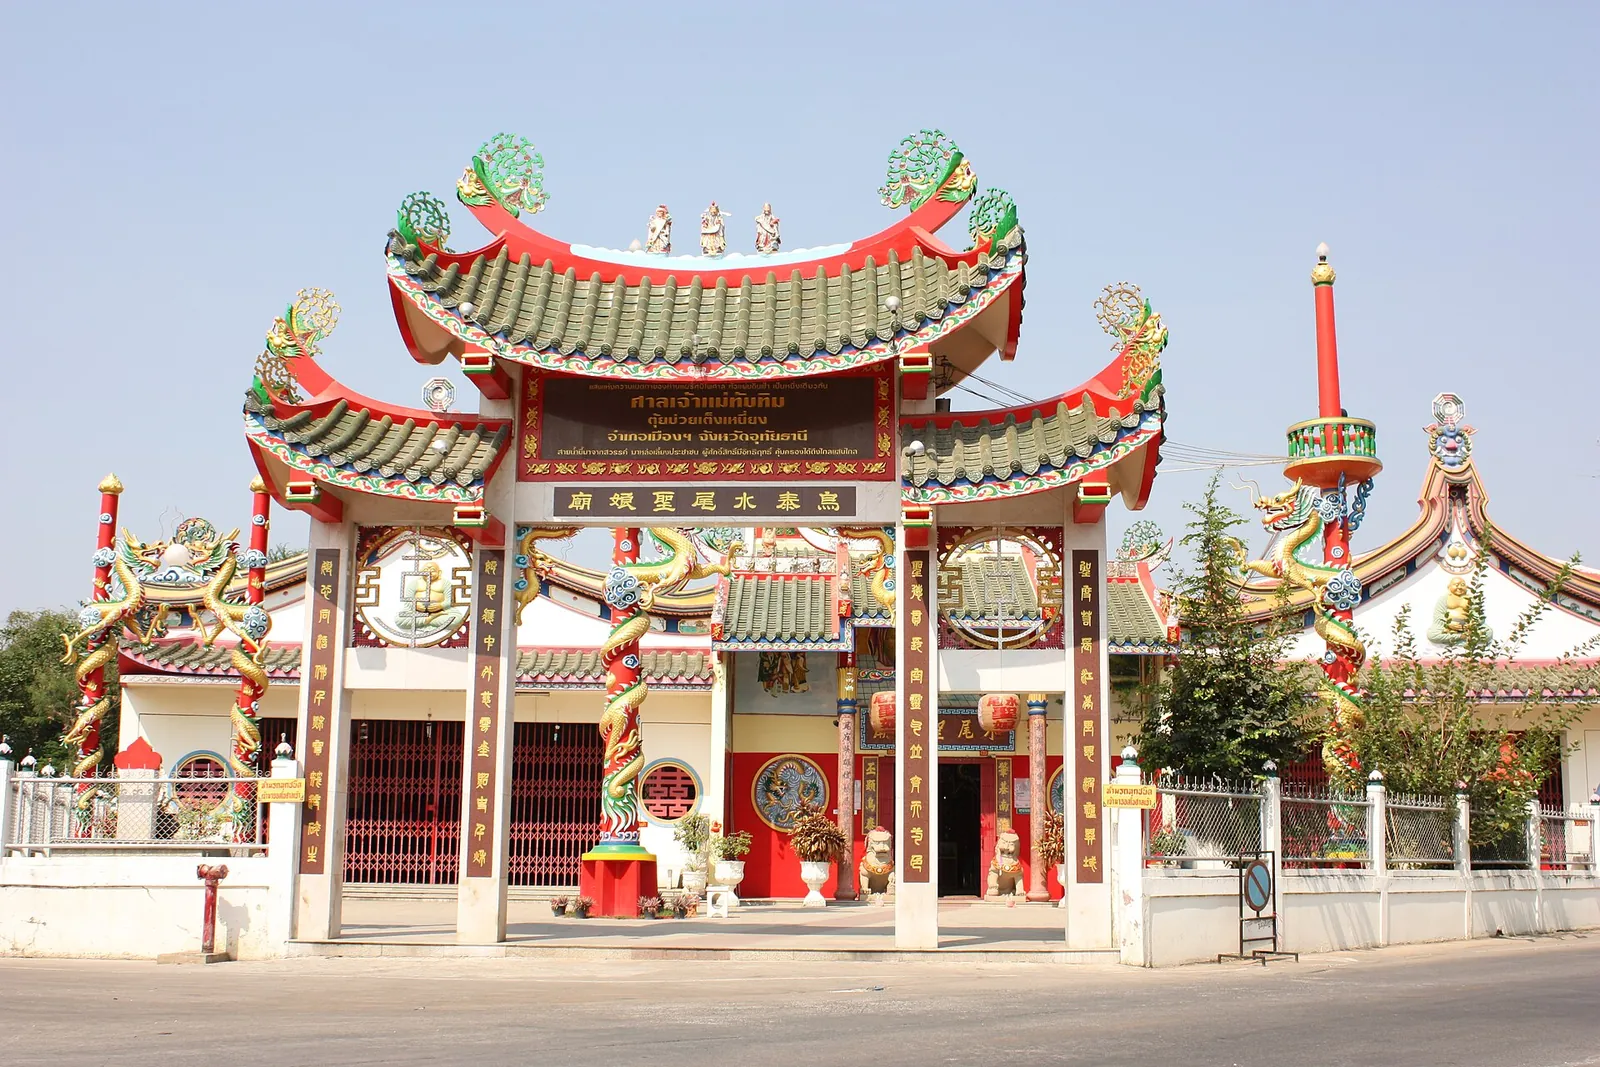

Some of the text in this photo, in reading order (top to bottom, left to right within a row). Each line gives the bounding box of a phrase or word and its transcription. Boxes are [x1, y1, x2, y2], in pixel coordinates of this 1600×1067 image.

[630, 392, 786, 409] ศาลเจ้าแม่ทับทิม
[698, 429, 809, 444] จังหวัดอุทัยธานี
